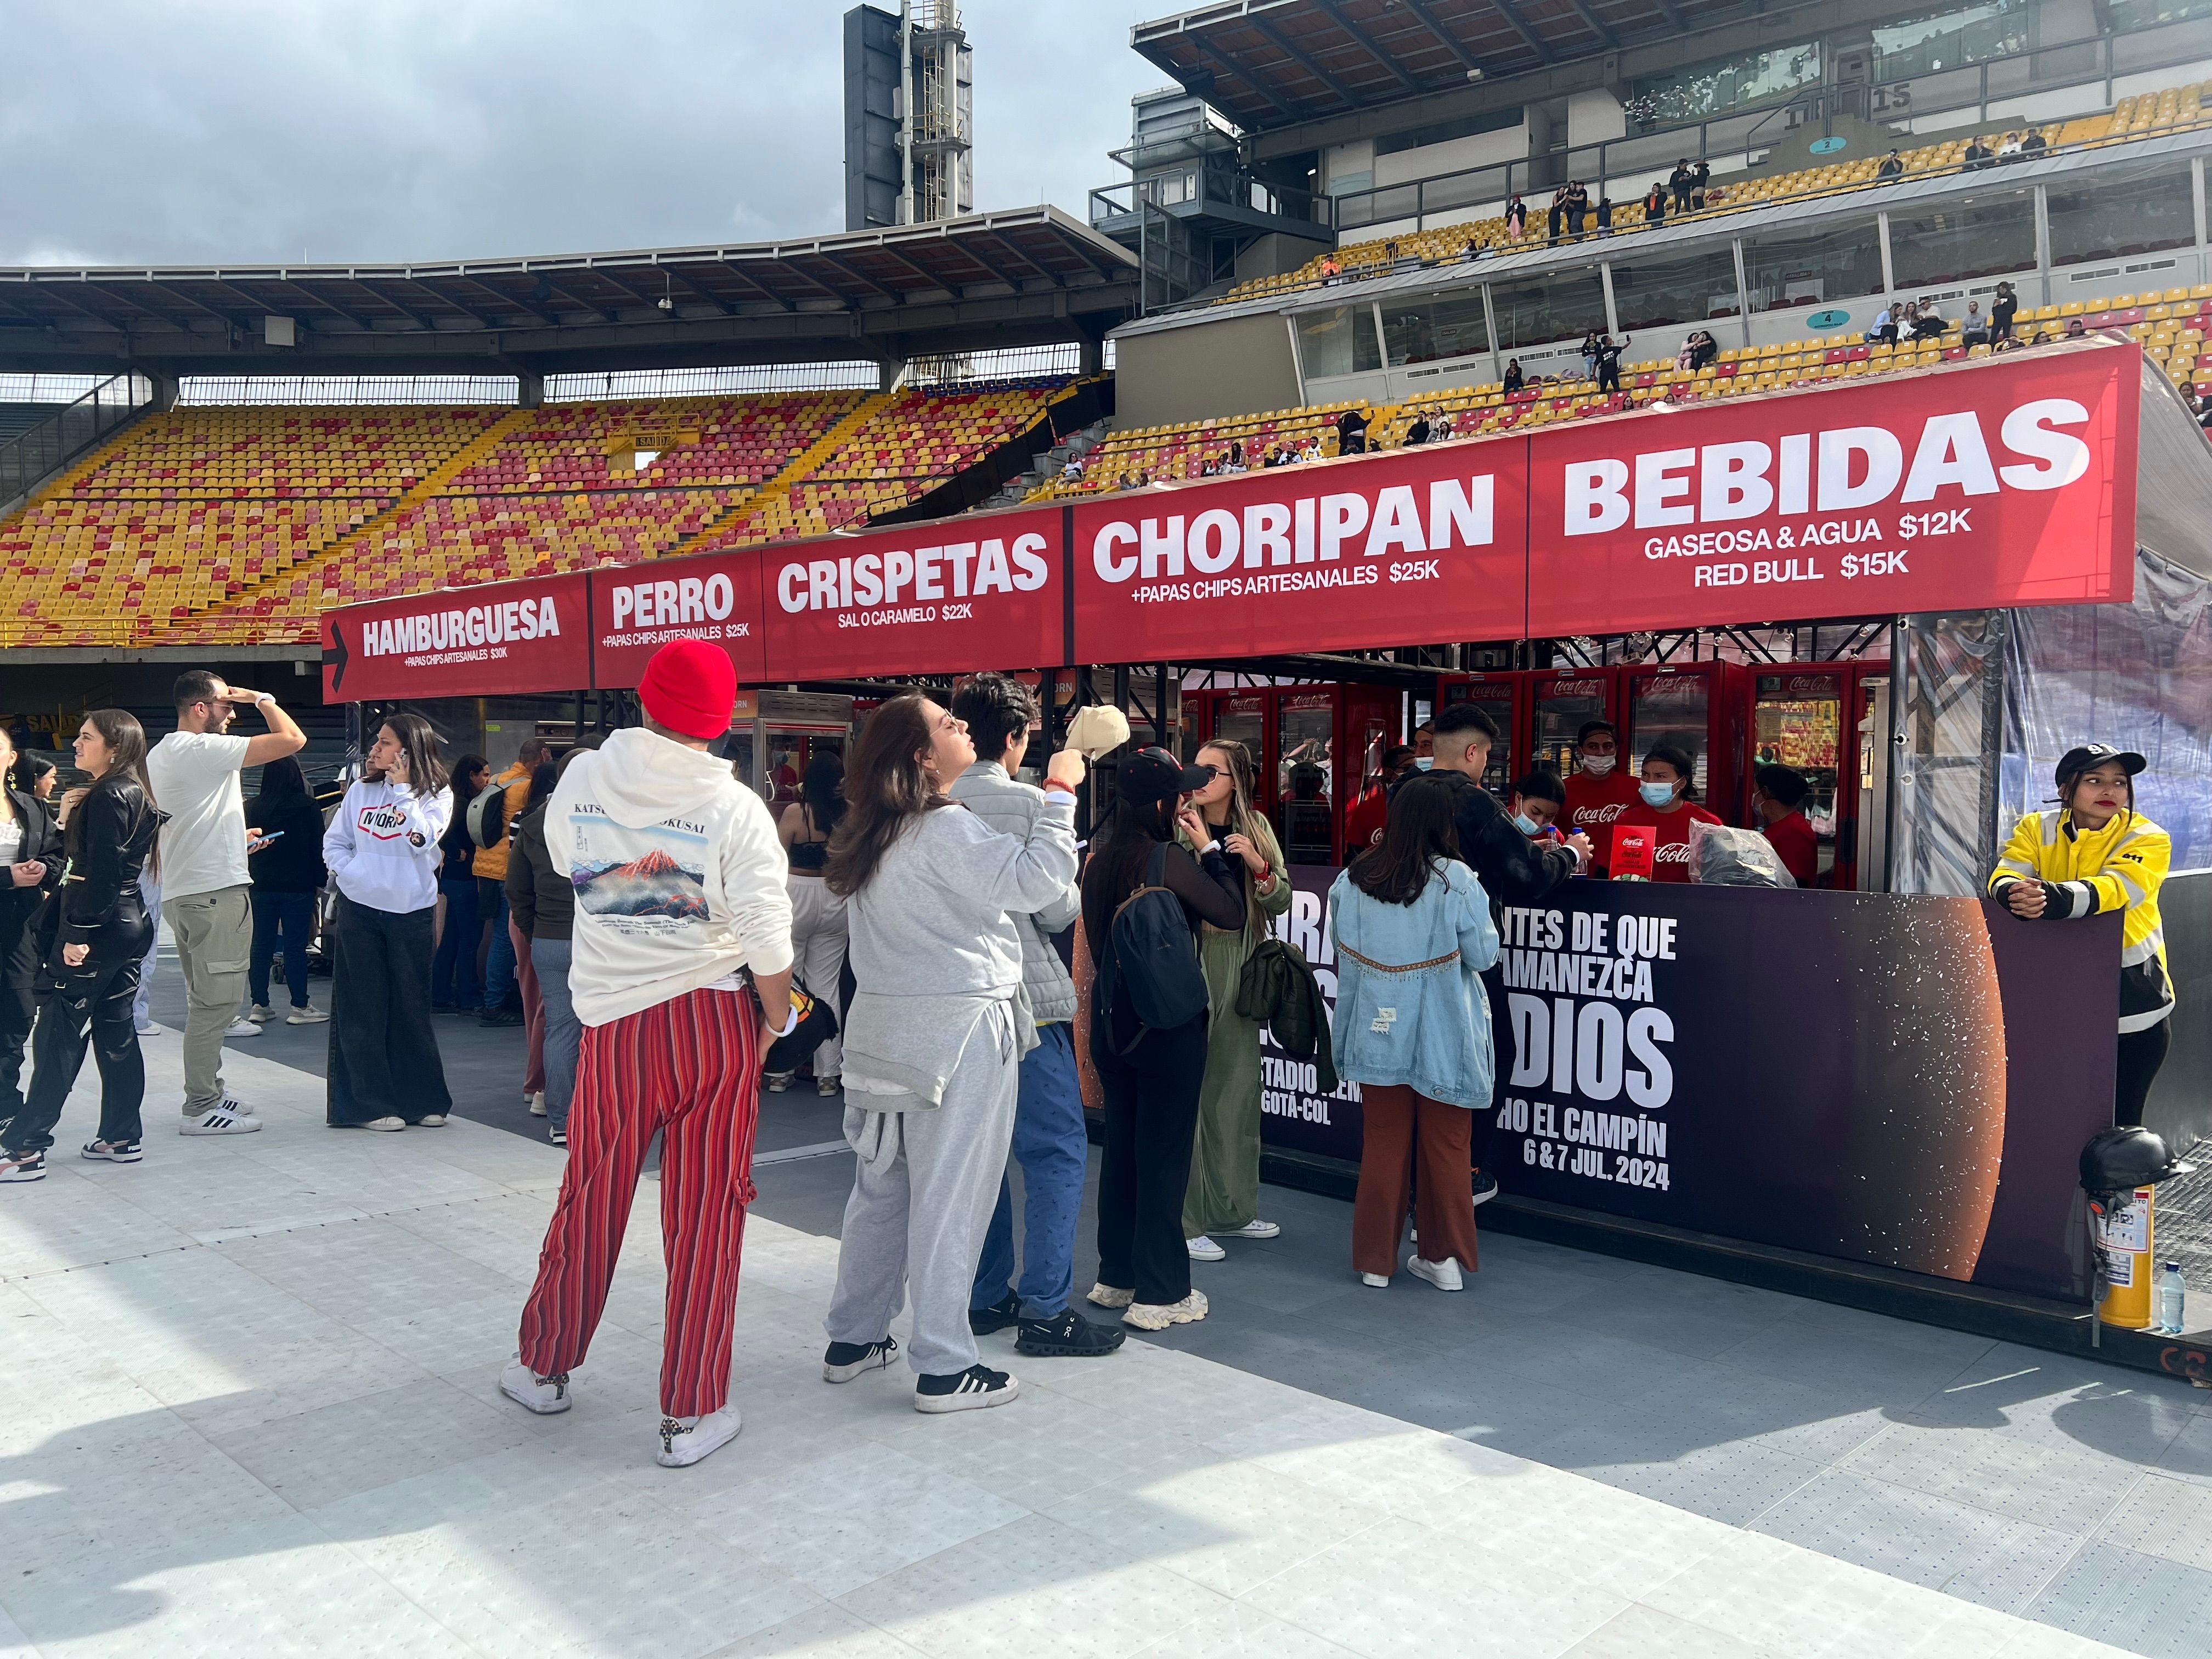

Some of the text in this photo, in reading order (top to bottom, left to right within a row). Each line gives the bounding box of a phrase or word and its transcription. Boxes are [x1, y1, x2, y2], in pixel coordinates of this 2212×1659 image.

[1873, 82, 1911, 112] 15
[1825, 140, 1830, 149] 2
[1825, 314, 1831, 323] 4
[1564, 398, 2090, 536] BEBIDAS
[1093, 473, 1494, 583] CHORIPAN
[1644, 507, 1972, 559] GASEOSA & AGUA $12K
[777, 533, 1048, 613] CRISPETAS
[1131, 558, 1440, 603] +PAPAS CHIPS ARTESANALES $25K
[1694, 550, 1909, 588] RED BULL $15K
[612, 573, 734, 629] PERRO
[838, 602, 973, 628] SAL O CARAMELO $22K
[363, 596, 560, 657] HAMBURGUESA
[602, 622, 750, 647] +PAPAS CHIPS ARTESANALES $25K
[404, 646, 508, 667] +PAPAS CHIPS ARTESANALES $30K
[1554, 679, 1599, 696] Coca-Cola
[26, 714, 79, 732] SALID
[1572, 804, 1629, 825] Coca-Col
[1572, 911, 1609, 954] DE
[1617, 915, 1677, 962] QUE
[1499, 948, 1654, 1002] AMANEZCA
[1508, 992, 1674, 1108] DIOS
[1261, 1056, 1317, 1094] TADIO
[1261, 1090, 1331, 1125] GOTÁ-COL
[1533, 1102, 1559, 1139] EL
[1564, 1107, 1667, 1158] CAMPÍN
[1523, 1138, 1670, 1191] 6 & 7 JUL. 2024
